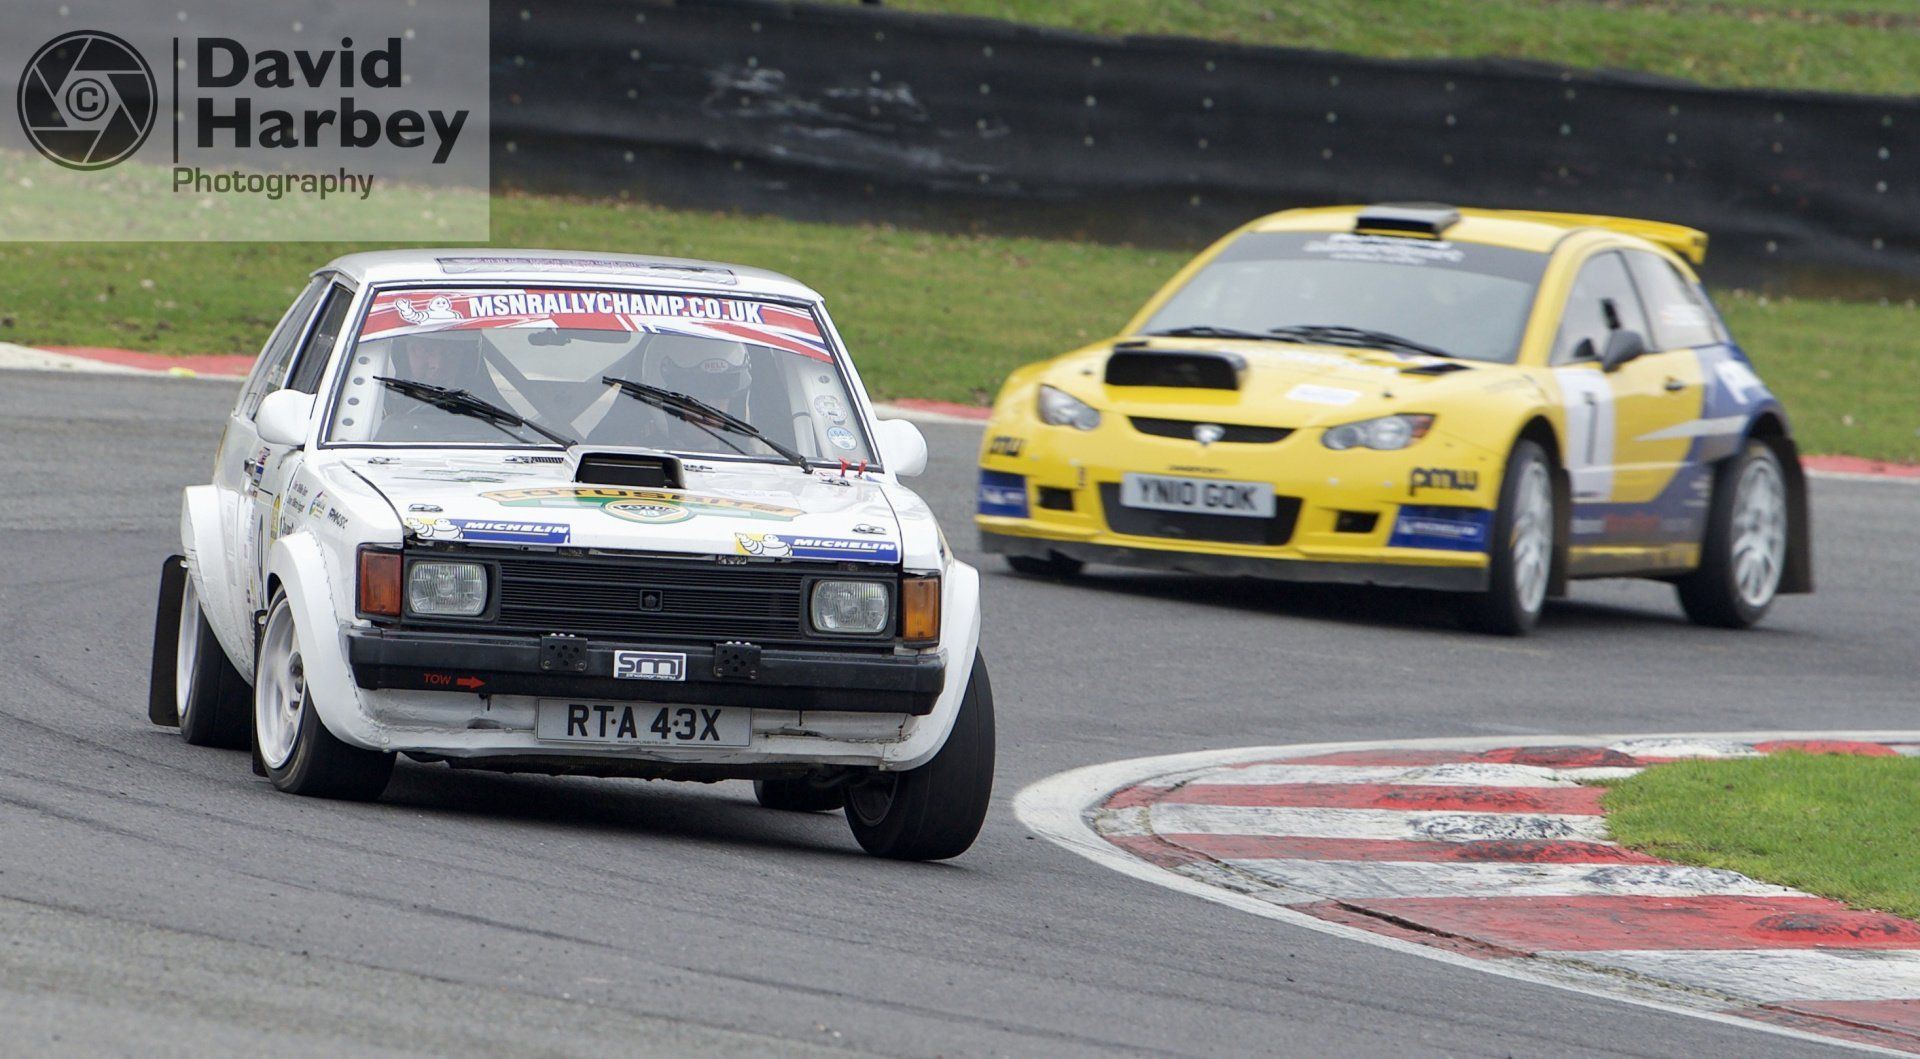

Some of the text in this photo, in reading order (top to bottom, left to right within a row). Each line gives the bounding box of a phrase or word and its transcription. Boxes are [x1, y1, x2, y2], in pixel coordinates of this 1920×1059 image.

[469, 293, 764, 323] MSNRALLYCHAMP.CO.UK
[1408, 467, 1478, 496] pmw
[465, 521, 569, 533] MICHELIN
[794, 538, 896, 550] MICHELIN
[423, 673, 452, 685] TOW
[567, 704, 721, 741] RTA 43X
